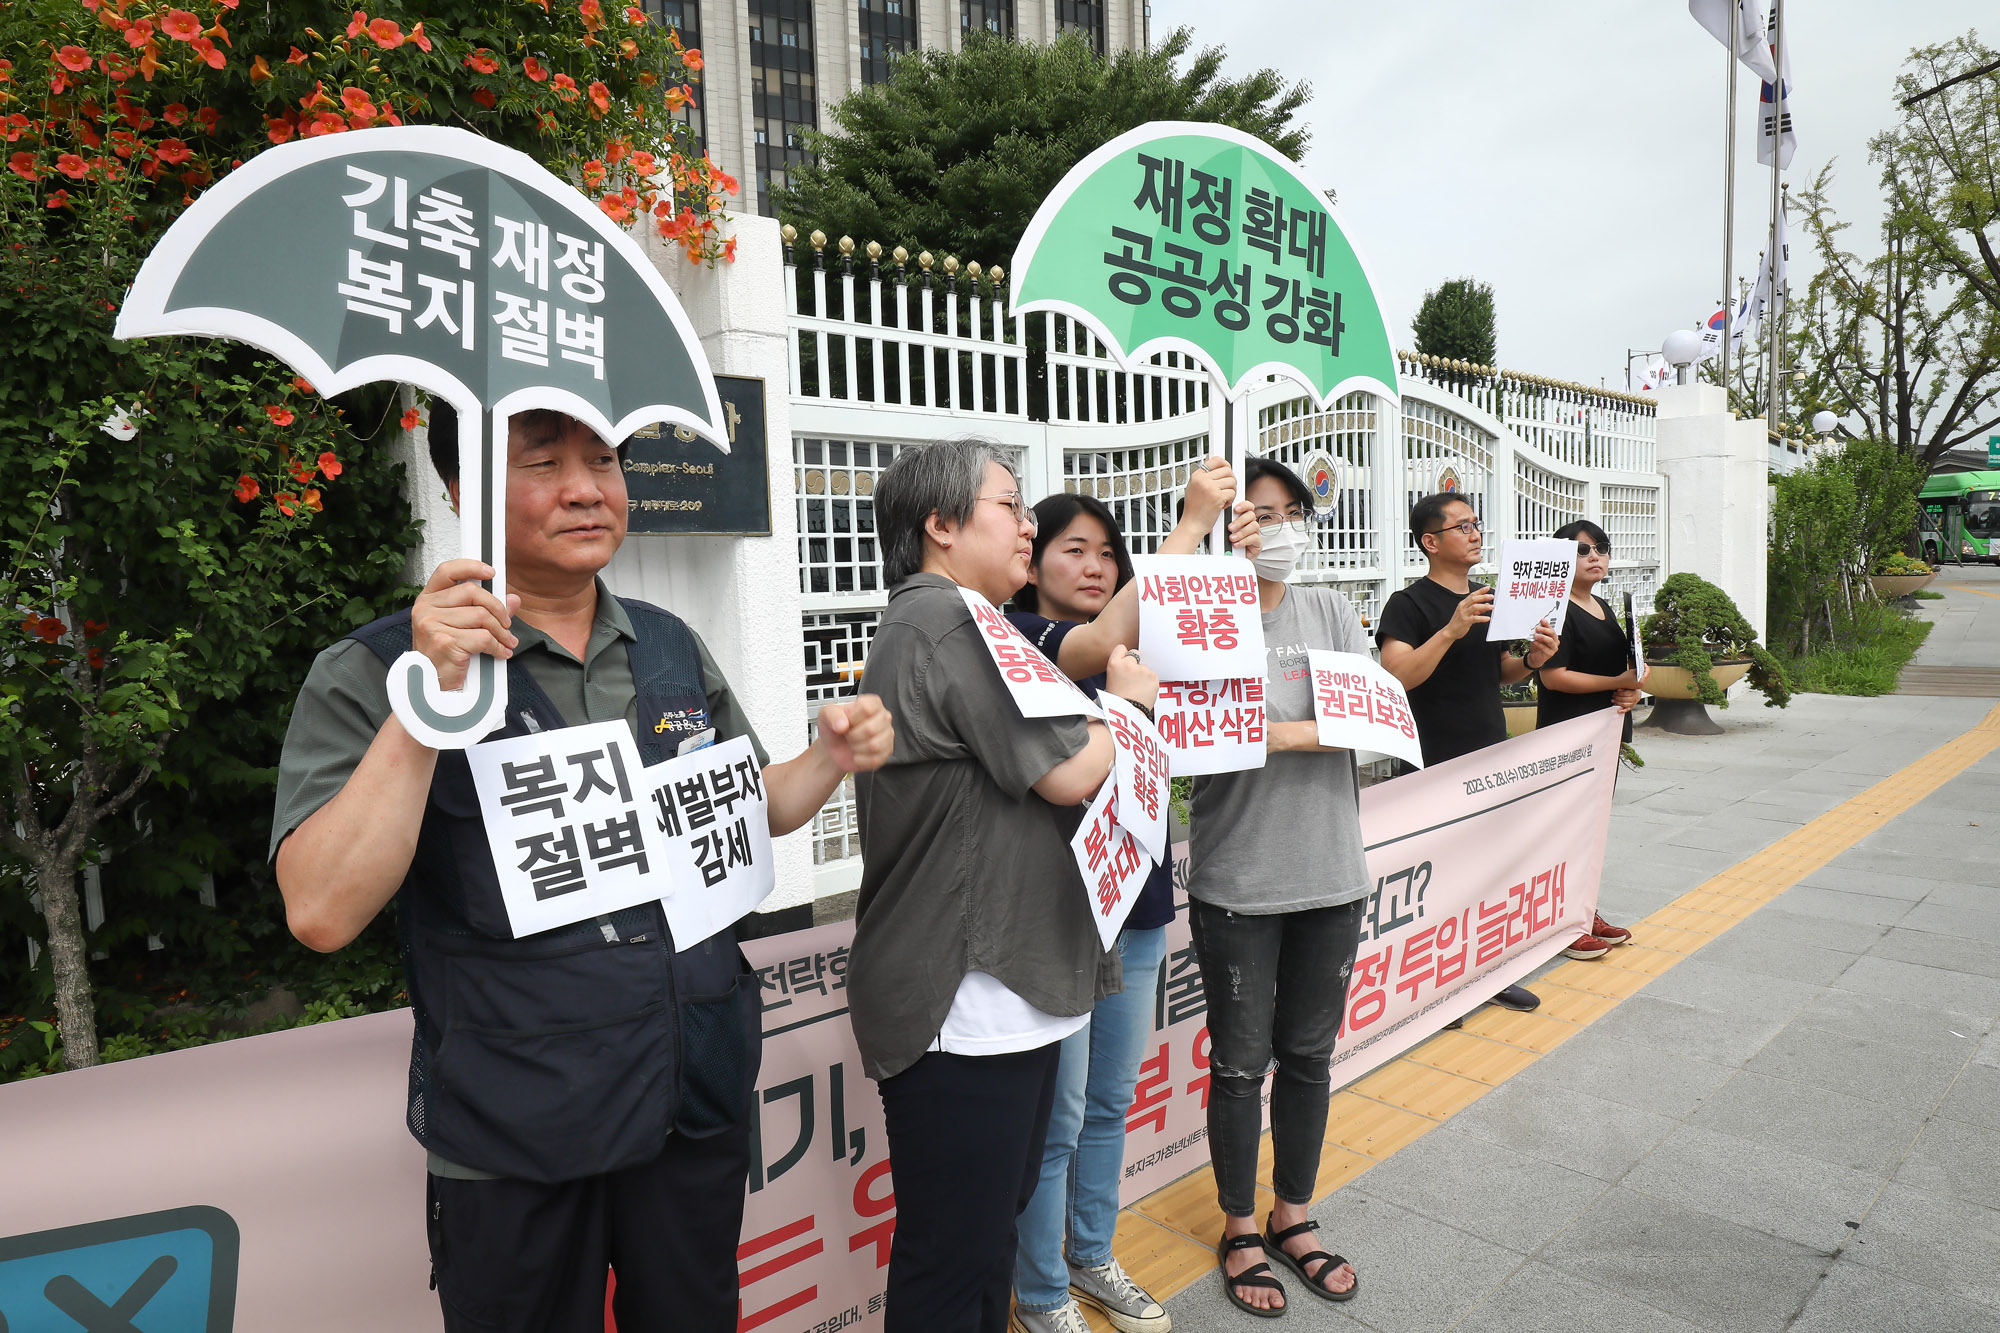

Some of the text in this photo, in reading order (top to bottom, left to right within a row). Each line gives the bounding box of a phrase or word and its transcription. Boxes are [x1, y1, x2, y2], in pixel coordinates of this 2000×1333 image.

[341, 164, 606, 304] 긴축 재정
[1133, 152, 1327, 279] 재정 확대
[337, 248, 605, 381] 복지 절벽
[1103, 225, 1346, 358] 공공성 강화
[1141, 575, 1257, 606] 사회안전망
[1509, 580, 1566, 600] 복지예산 확충
[1512, 560, 1570, 580] 약자 권리보장
[1176, 608, 1239, 650] 확충
[1315, 669, 1372, 695] 장애인,
[1317, 688, 1416, 739] 권리보장
[1108, 708, 1170, 792] 공공임대
[1158, 706, 1265, 749] 예산 삭감
[500, 741, 634, 819] 복지
[1133, 763, 1159, 821] 확충
[1463, 777, 1488, 795] 2023.
[1485, 774, 1495, 789] 6.
[1518, 762, 1538, 780] 09:30
[515, 810, 650, 901] 절벽
[690, 816, 753, 888] 감세
[1096, 831, 1142, 918] 확대
[1338, 944, 1393, 1041] 정
[1395, 907, 1470, 1003] 투입
[1475, 861, 1567, 967] 늘려라!
